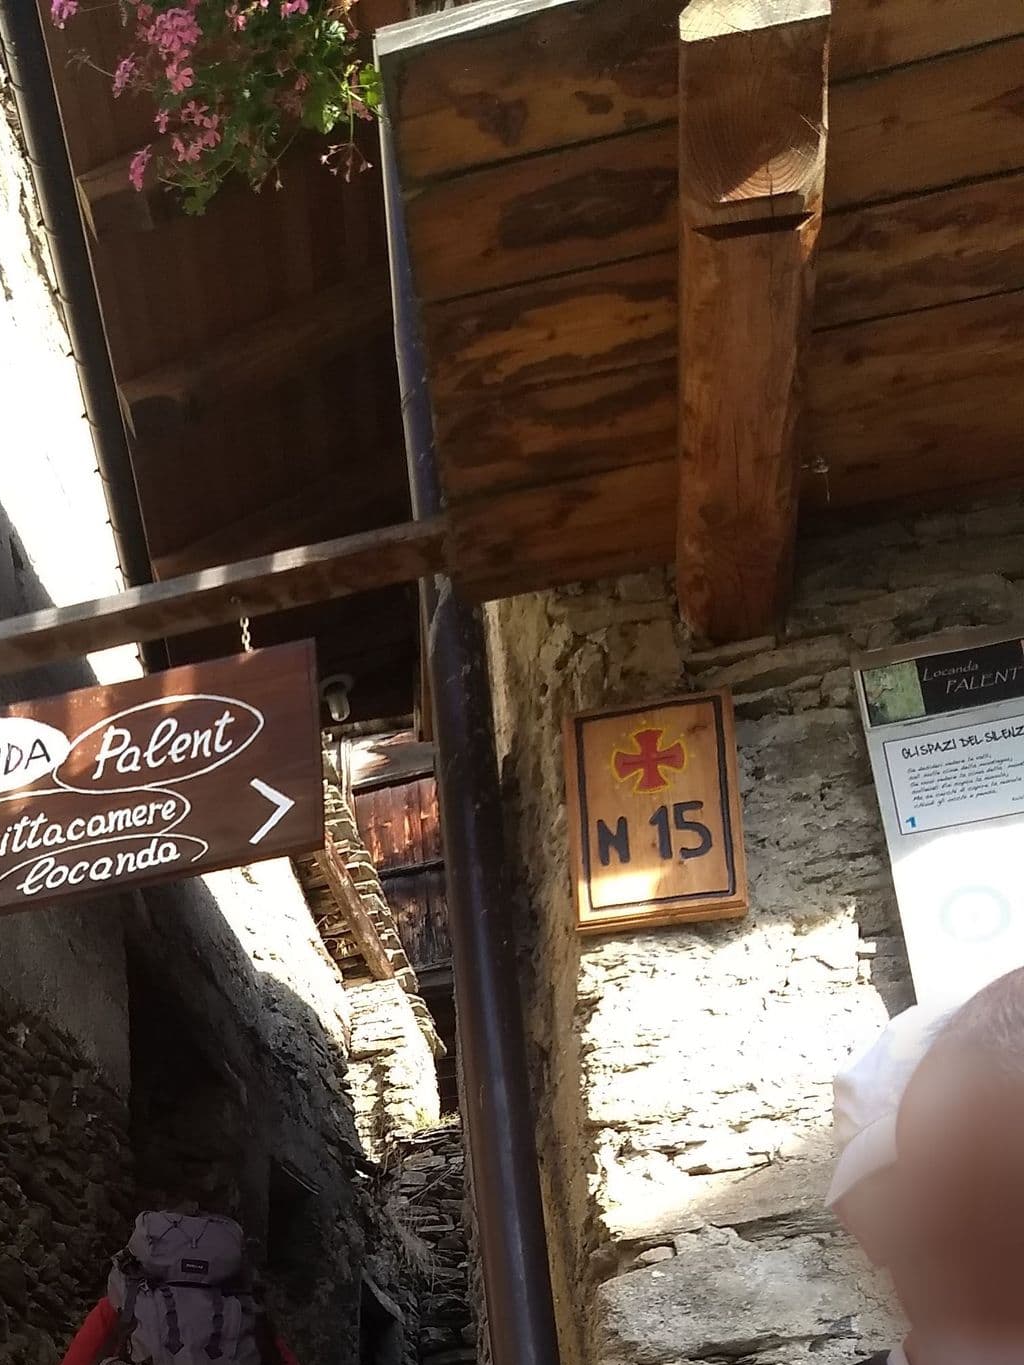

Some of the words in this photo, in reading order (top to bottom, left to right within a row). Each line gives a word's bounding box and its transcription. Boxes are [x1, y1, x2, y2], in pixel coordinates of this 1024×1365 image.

[922, 659, 979, 682] Locanda
[92, 709, 235, 781] Palent
[919, 738, 957, 756] SPAZI
[959, 735, 982, 748] DEL
[597, 816, 631, 866] N
[649, 800, 713, 860] 15
[906, 815, 918, 829] 1
[16, 837, 181, 896] locanda
